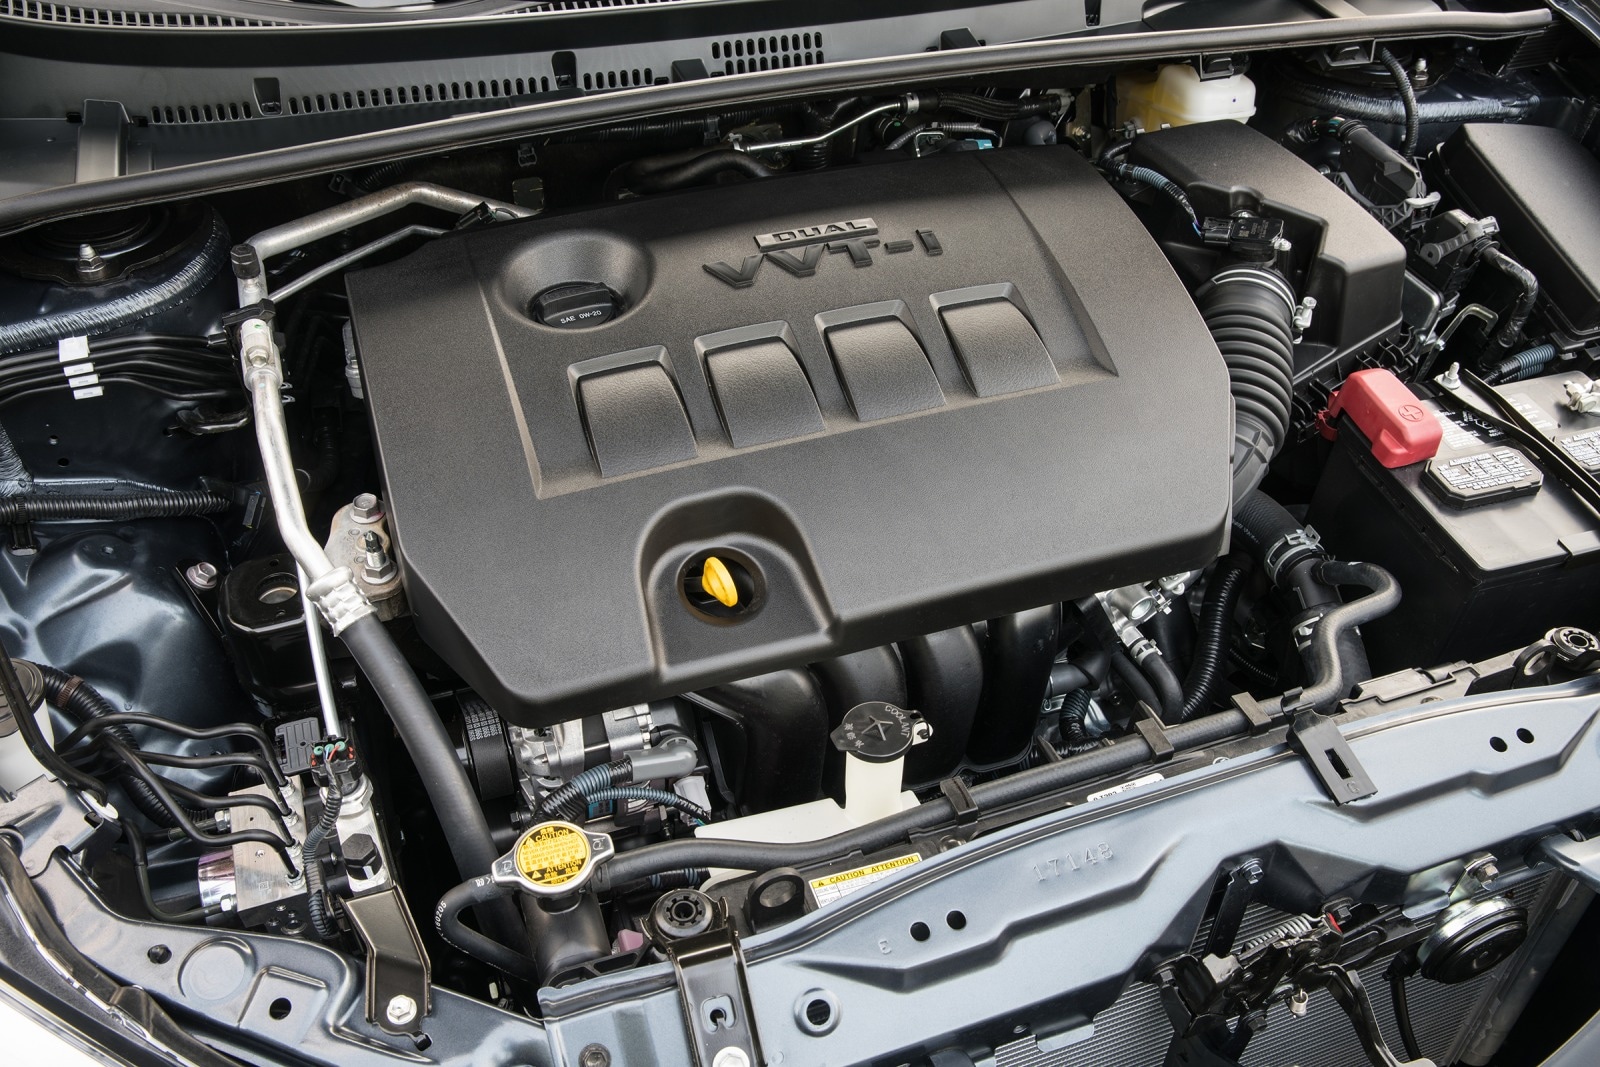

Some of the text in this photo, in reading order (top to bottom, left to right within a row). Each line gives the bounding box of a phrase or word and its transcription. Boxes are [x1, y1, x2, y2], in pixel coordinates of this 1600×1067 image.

[772, 222, 867, 242] DUAL
[561, 315, 576, 324] SAE
[885, 705, 911, 738] COOLANT
[535, 829, 569, 842] CAUTION
[546, 859, 582, 873] ATTENTION
[830, 857, 914, 883] CAUTION ATTENTION
